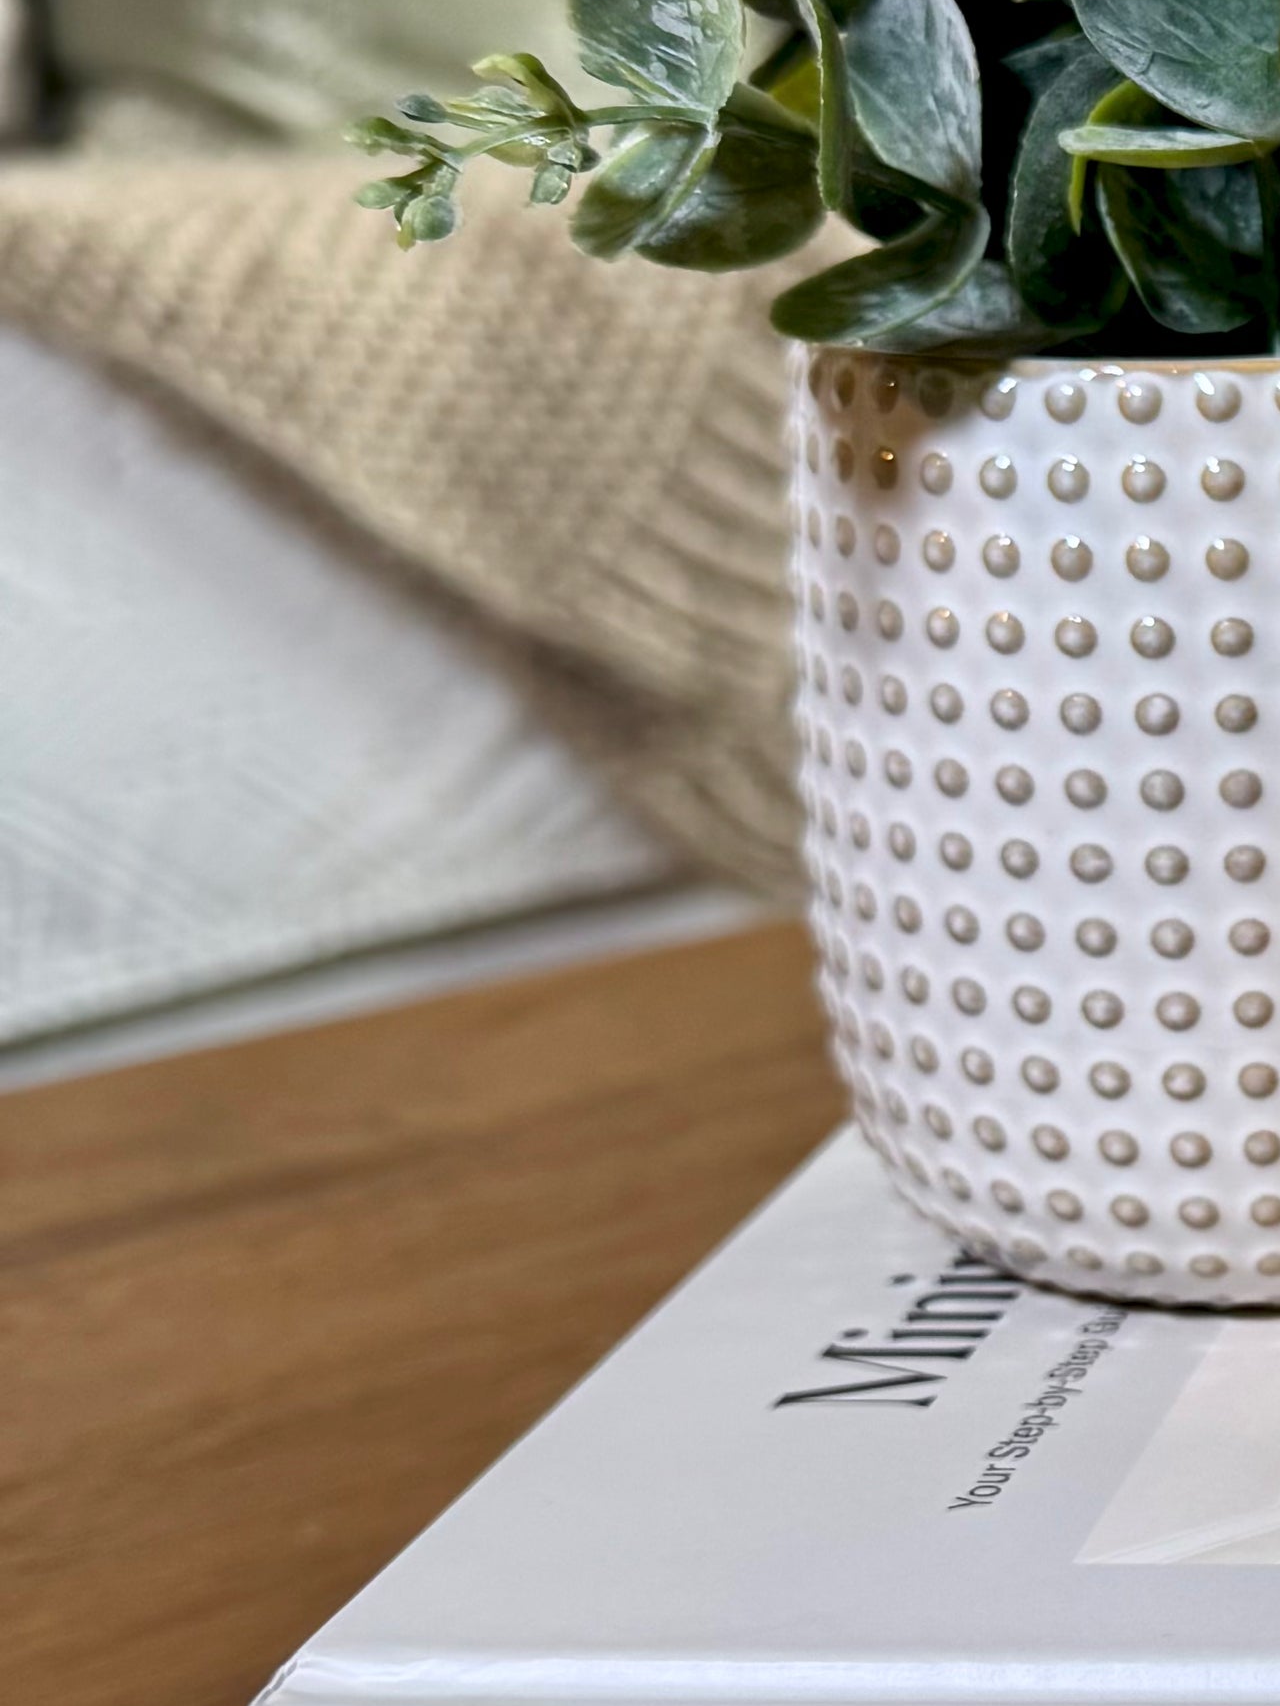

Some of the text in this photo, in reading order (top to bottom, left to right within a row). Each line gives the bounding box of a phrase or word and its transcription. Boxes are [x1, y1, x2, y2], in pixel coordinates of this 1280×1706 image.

[770, 1244, 1025, 1408] Mini
[947, 1464, 1016, 1510] Your
[987, 1339, 1113, 1459] Step-by-Step
